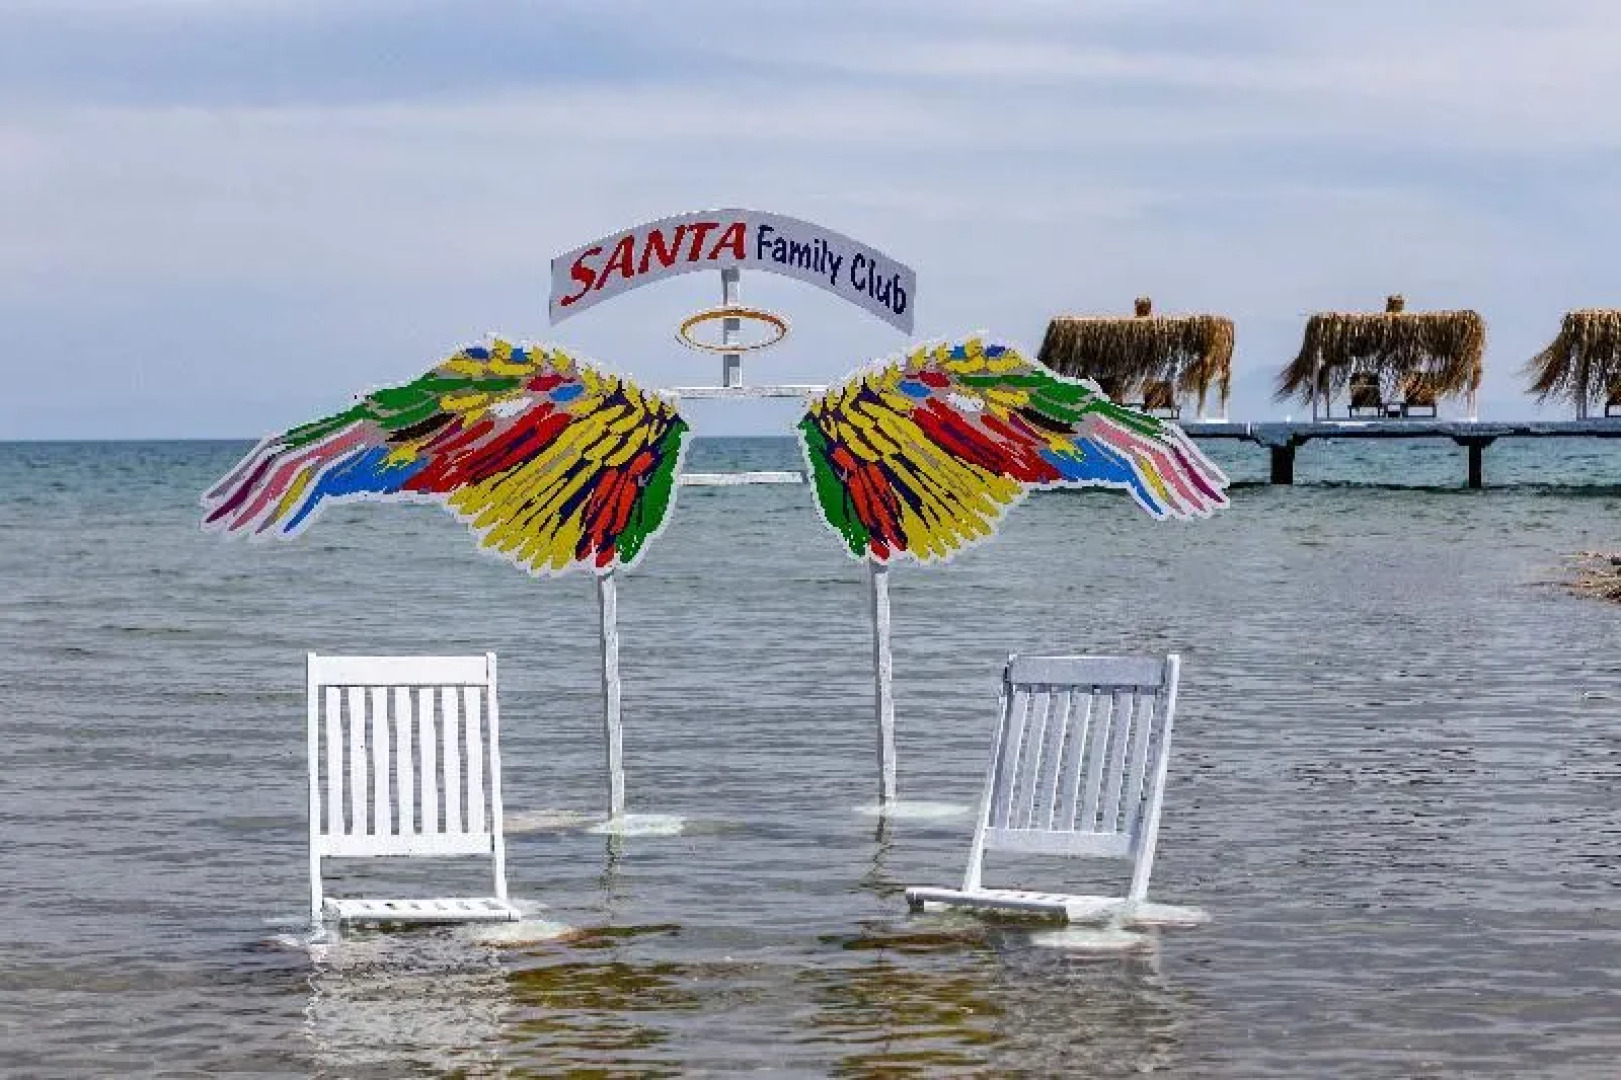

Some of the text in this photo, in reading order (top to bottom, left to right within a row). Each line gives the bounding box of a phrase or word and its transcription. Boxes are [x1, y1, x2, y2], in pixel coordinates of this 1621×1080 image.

[560, 222, 907, 314] SANTA Family Club
